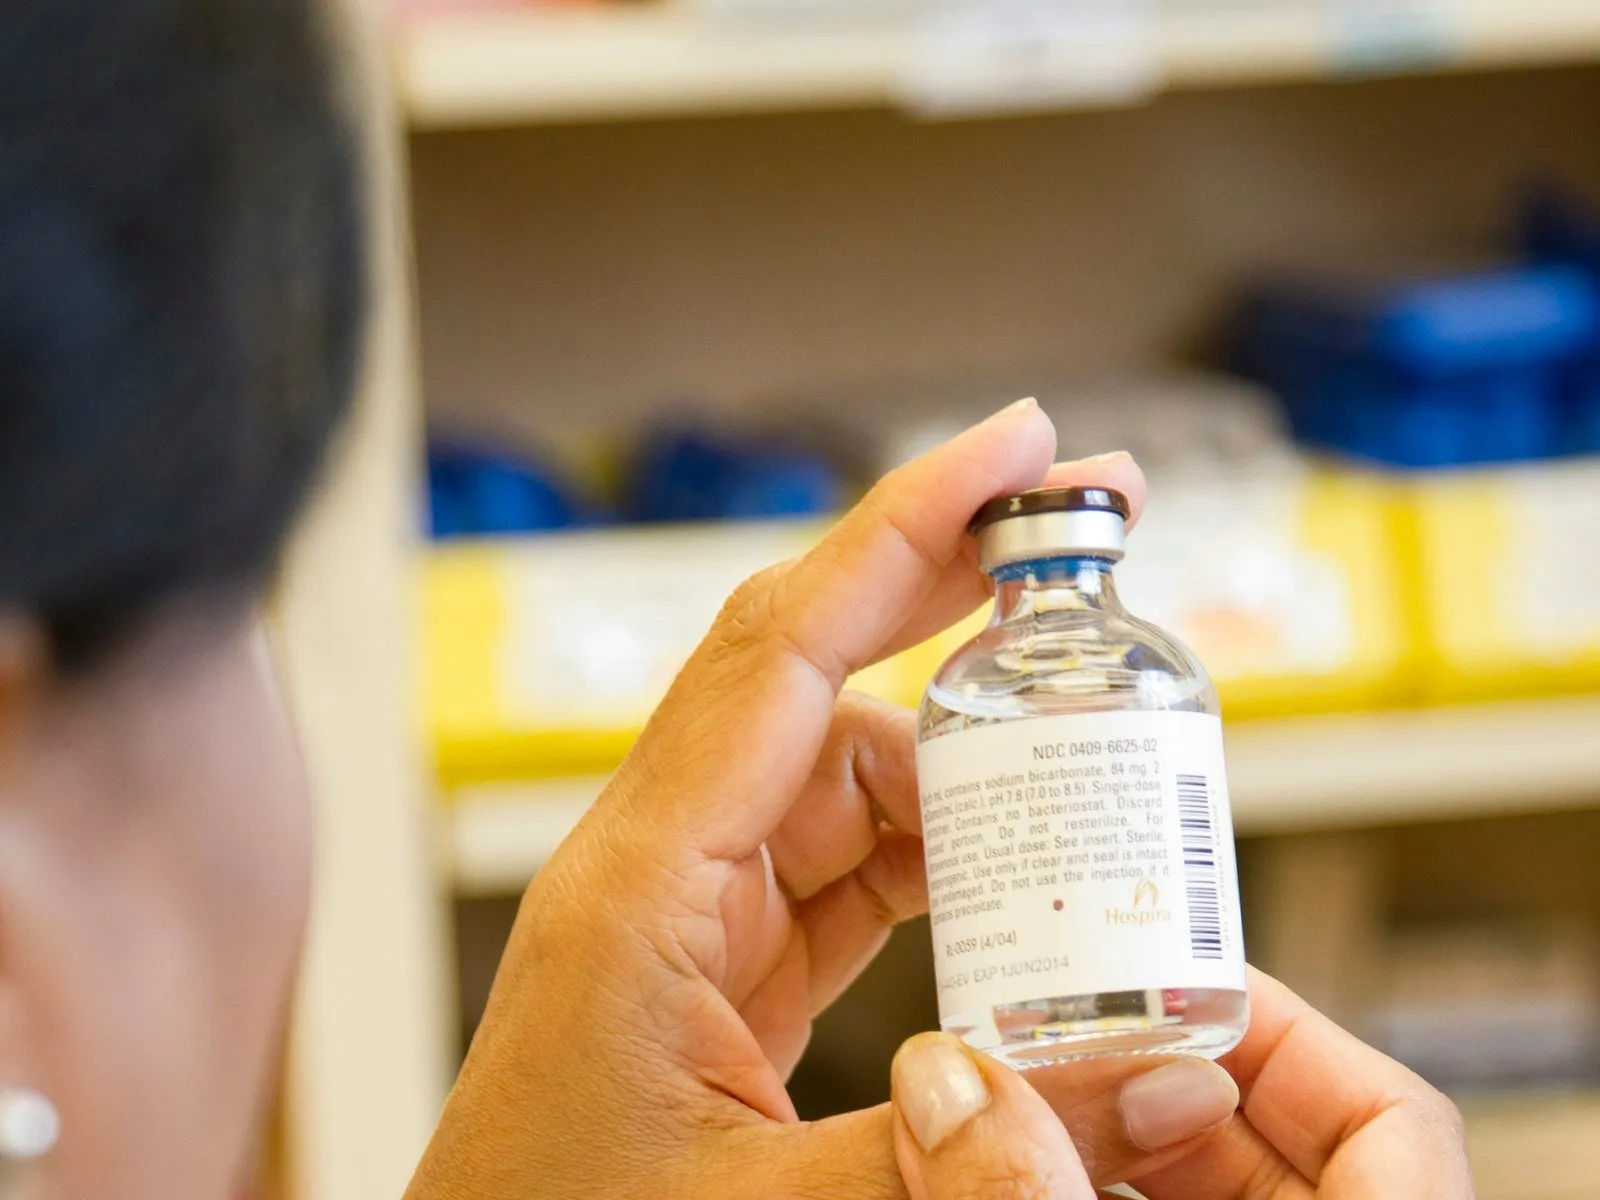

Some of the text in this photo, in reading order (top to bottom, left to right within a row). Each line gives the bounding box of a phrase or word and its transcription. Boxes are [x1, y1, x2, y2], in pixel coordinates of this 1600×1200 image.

[1033, 738, 1158, 760] NDC 0409-6625-02
[944, 782, 980, 799] contains
[985, 773, 1025, 788] sodium
[1028, 764, 1106, 783] bicarbonate,
[1111, 762, 1124, 775] 84
[1154, 761, 1160, 773] 2
[989, 794, 1004, 808] pH
[1049, 786, 1061, 798] to
[1093, 780, 1161, 795] Single-dose
[955, 813, 998, 831] Contains
[1005, 810, 1020, 821] no
[1117, 796, 1162, 810] Discard
[998, 826, 1015, 840] Do
[1029, 823, 1049, 836] not
[1146, 812, 1163, 826] For
[984, 844, 1014, 859] Usual
[1018, 839, 1049, 854] dose:
[1054, 835, 1078, 850] See
[973, 864, 992, 879] Use
[995, 860, 1018, 876] only
[1021, 857, 1028, 868] if
[1032, 855, 1061, 869] clear
[1066, 852, 1089, 865] and
[1093, 850, 1119, 863] seal
[1122, 848, 1133, 861] is
[1136, 847, 1168, 860] intact
[991, 879, 1006, 893] Do
[1012, 876, 1031, 890] not
[1036, 874, 1057, 886] use
[1064, 869, 1084, 883] the
[1091, 865, 1143, 882] injection
[1149, 865, 1156, 877] if
[1162, 865, 1170, 877] it
[1105, 908, 1171, 926] Hospira
[980, 930, 1017, 952] (4/04)
[974, 967, 998, 983] EXP
[1001, 956, 1070, 979] 1JUN2014
